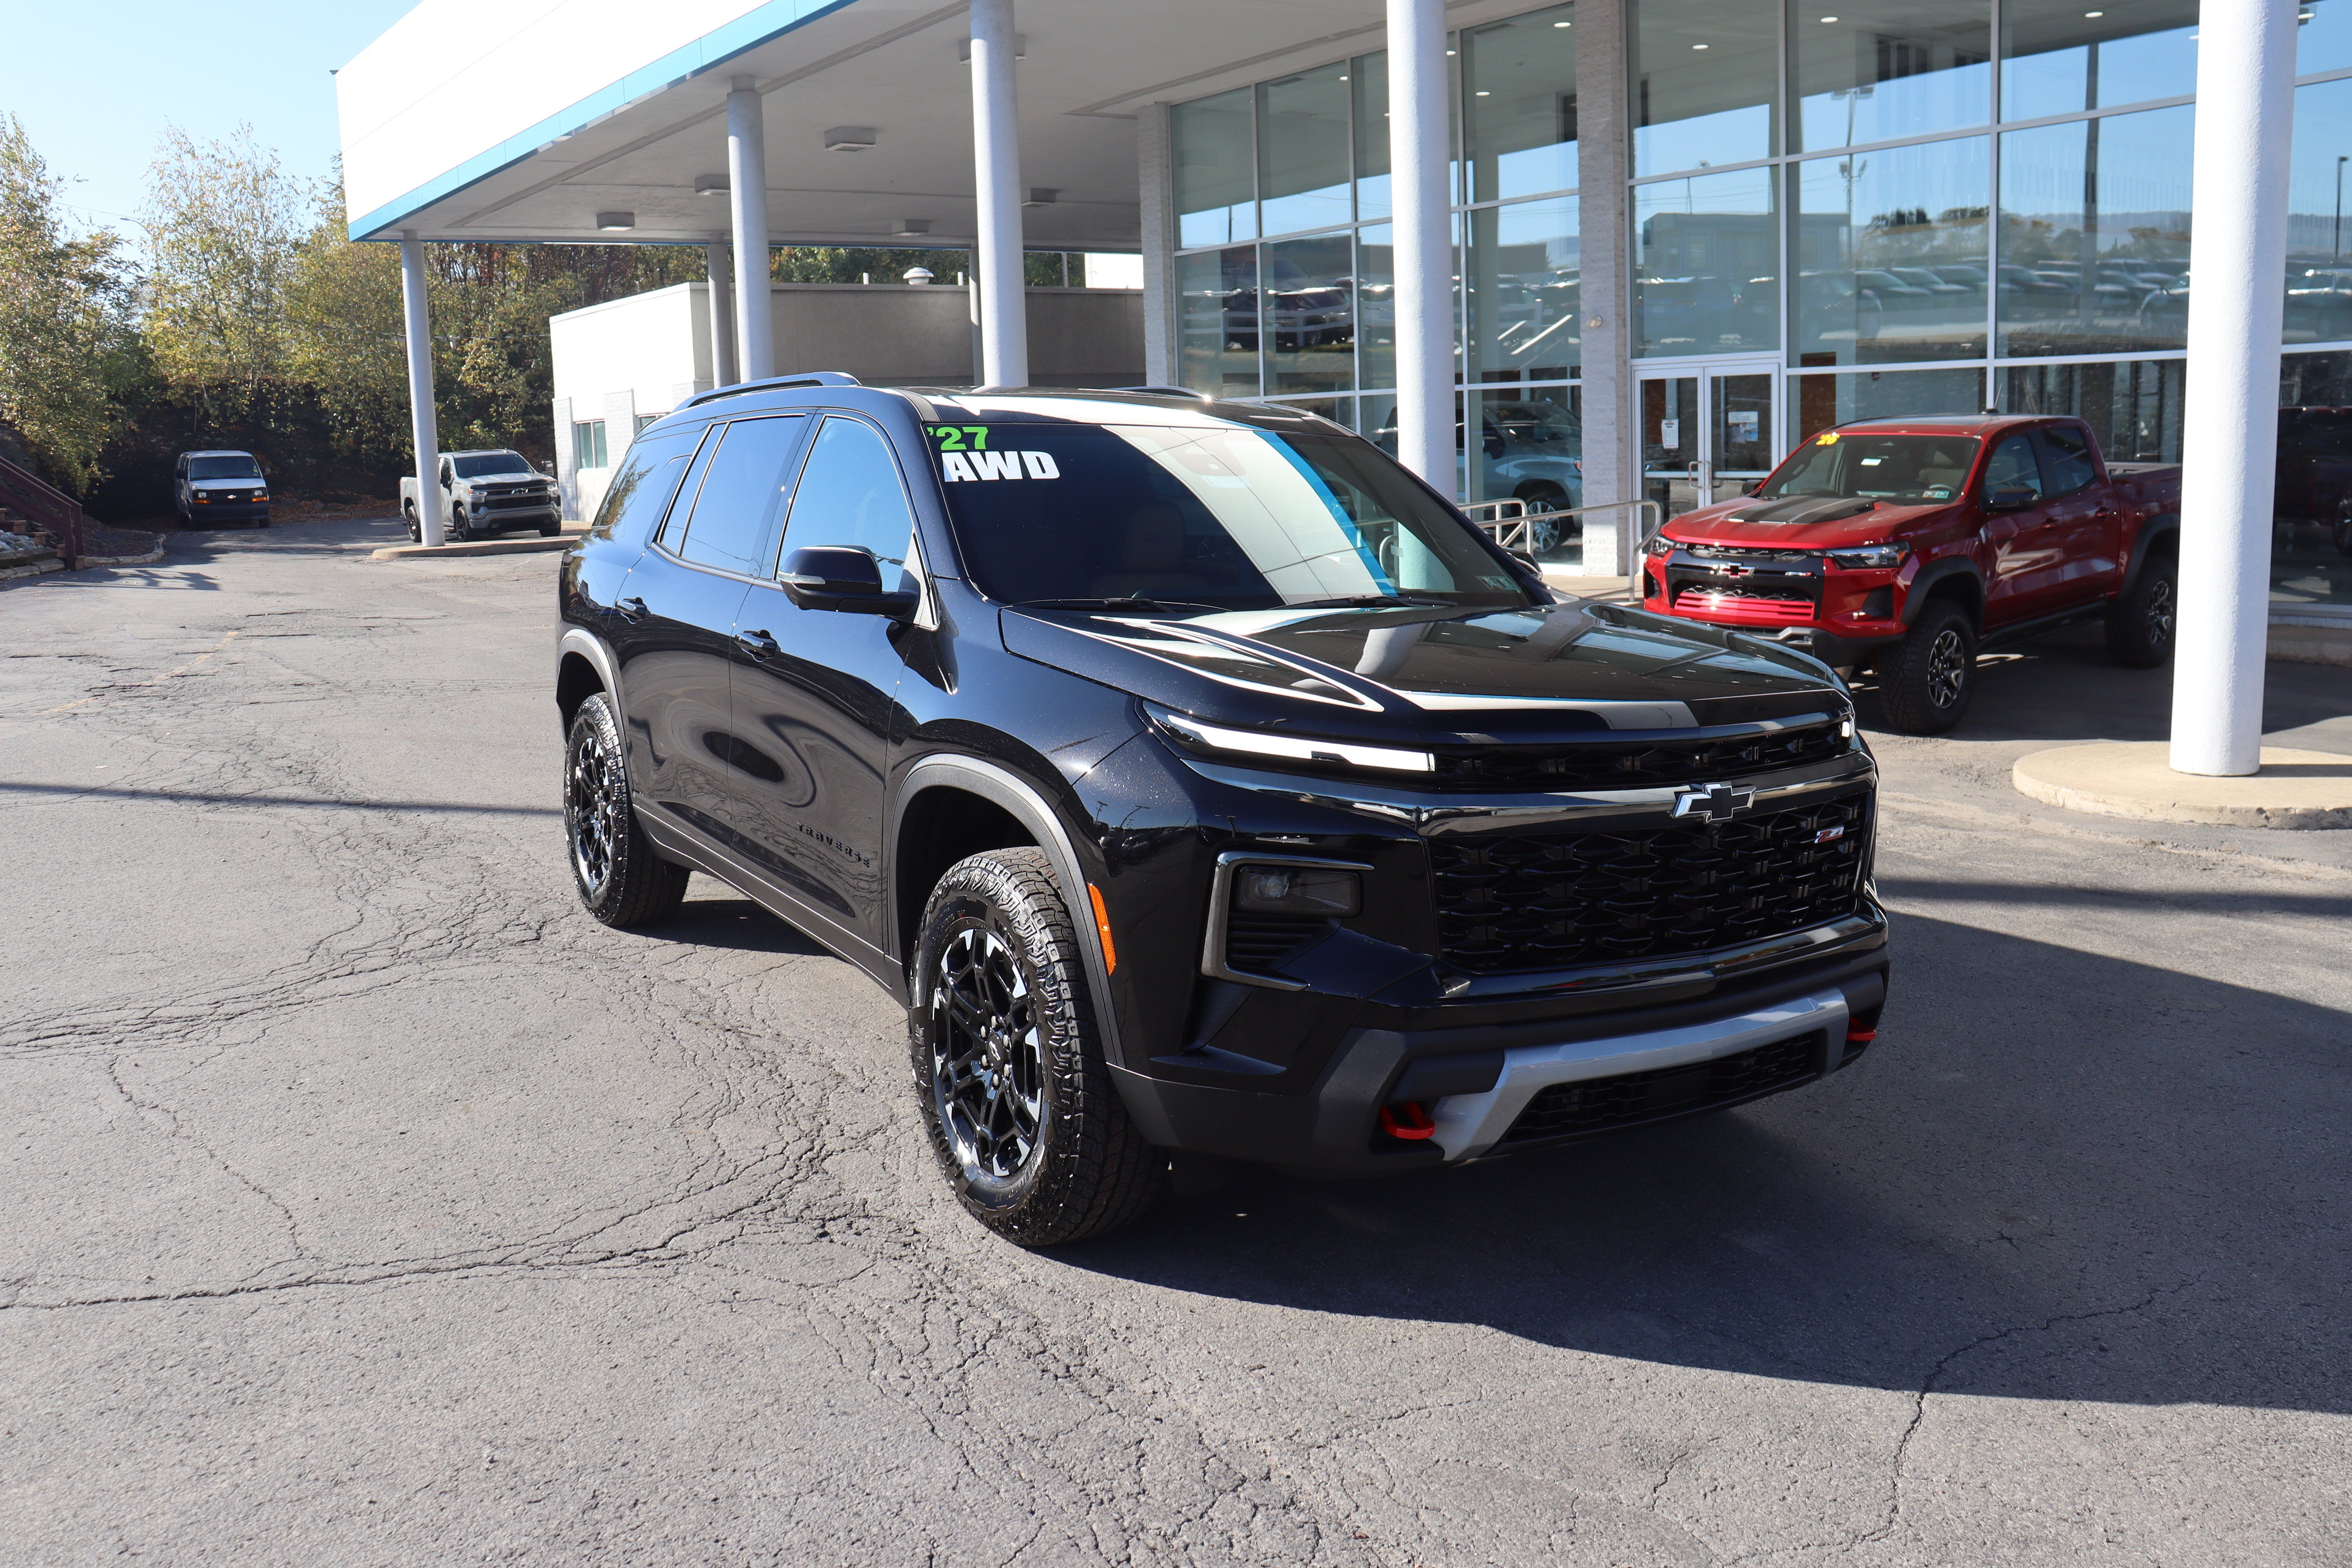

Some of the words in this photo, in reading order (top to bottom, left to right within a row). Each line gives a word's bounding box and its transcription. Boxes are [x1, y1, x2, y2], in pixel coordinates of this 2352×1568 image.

[927, 426, 989, 450] '27
[941, 451, 1060, 482] AWD
[796, 821, 871, 868] TRAVERSE
